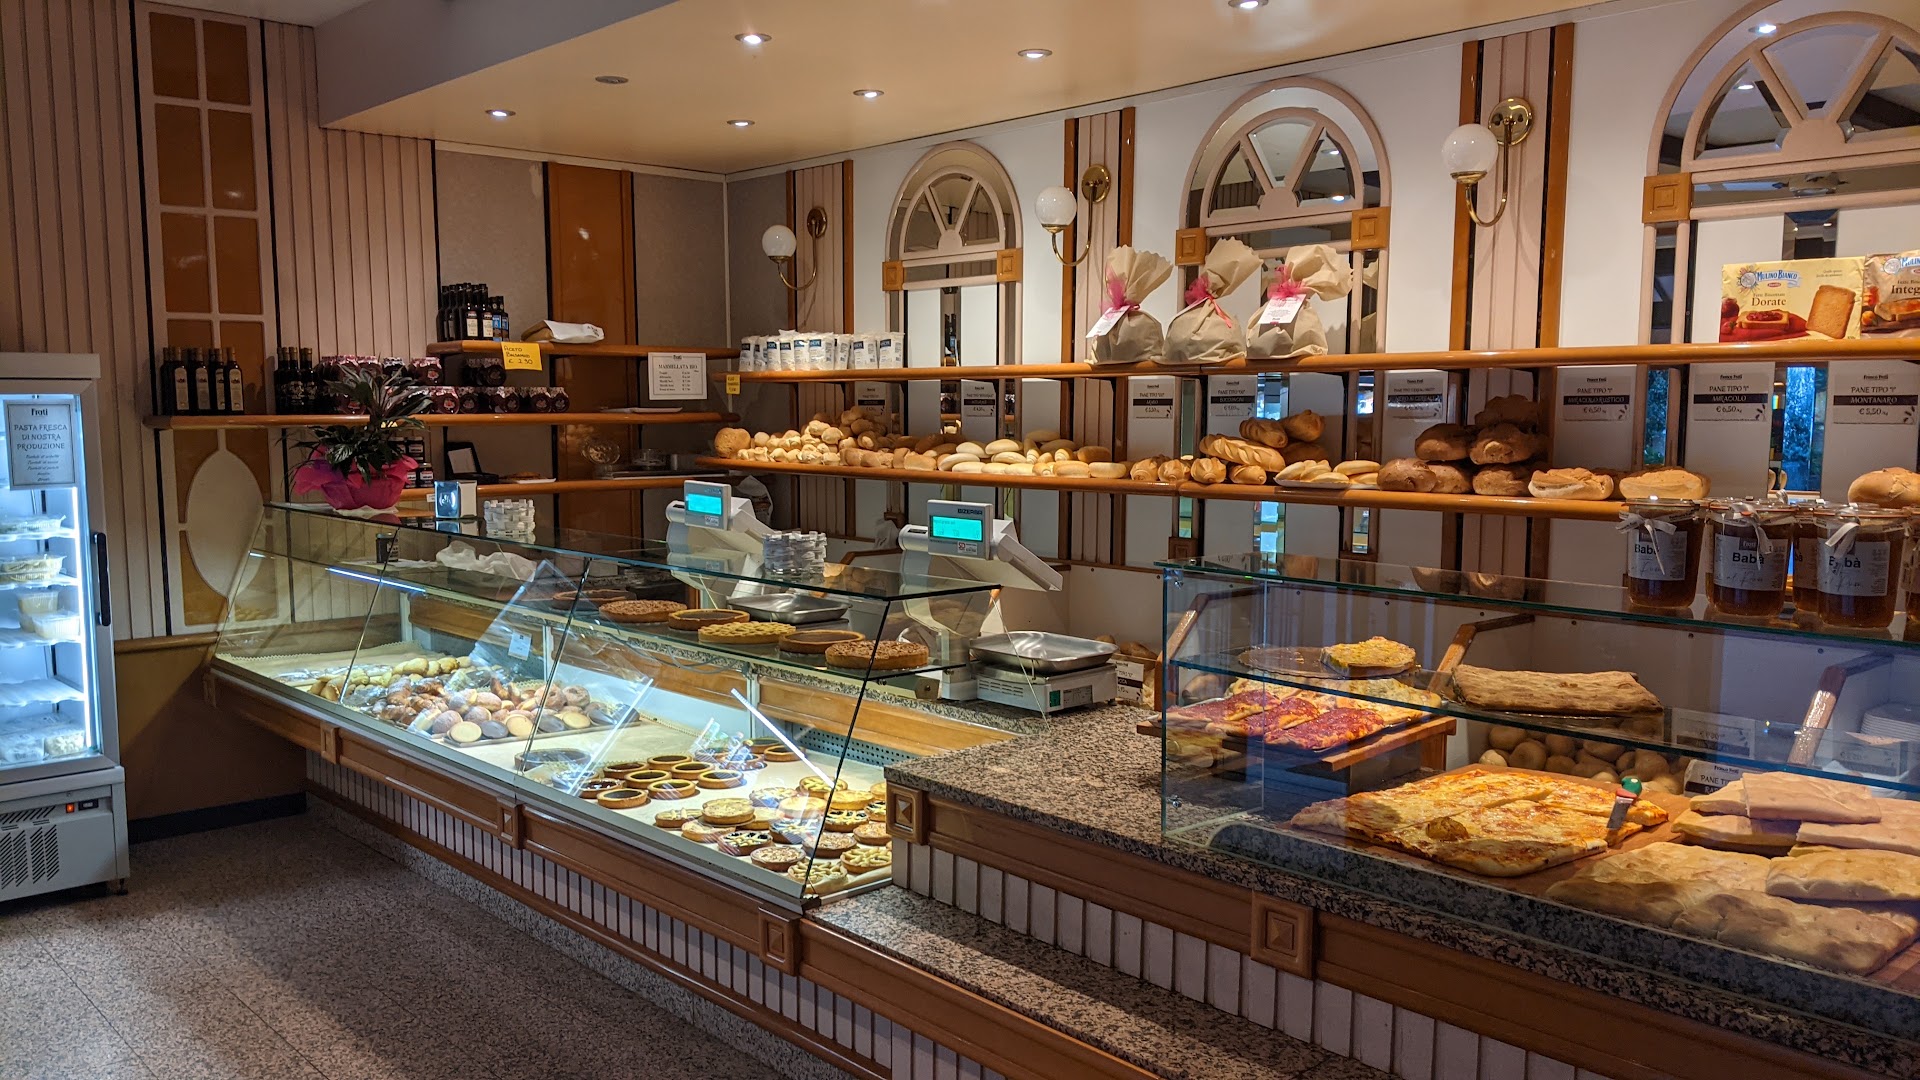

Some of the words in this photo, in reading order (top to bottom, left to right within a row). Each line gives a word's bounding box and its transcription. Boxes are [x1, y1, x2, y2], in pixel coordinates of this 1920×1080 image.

[1757, 271, 1778, 280] MULINO
[1779, 270, 1798, 279] BIANCO
[1751, 297, 1787, 306] Dorate
[1851, 396, 1898, 404] MONTANARO
[39, 424, 67, 432] FRESCA
[31, 433, 61, 441] NOSTRA
[17, 443, 65, 451] PRODUZIONE
[1829, 556, 1861, 568] Bbà
[1700, 775, 1719, 784] PANE
